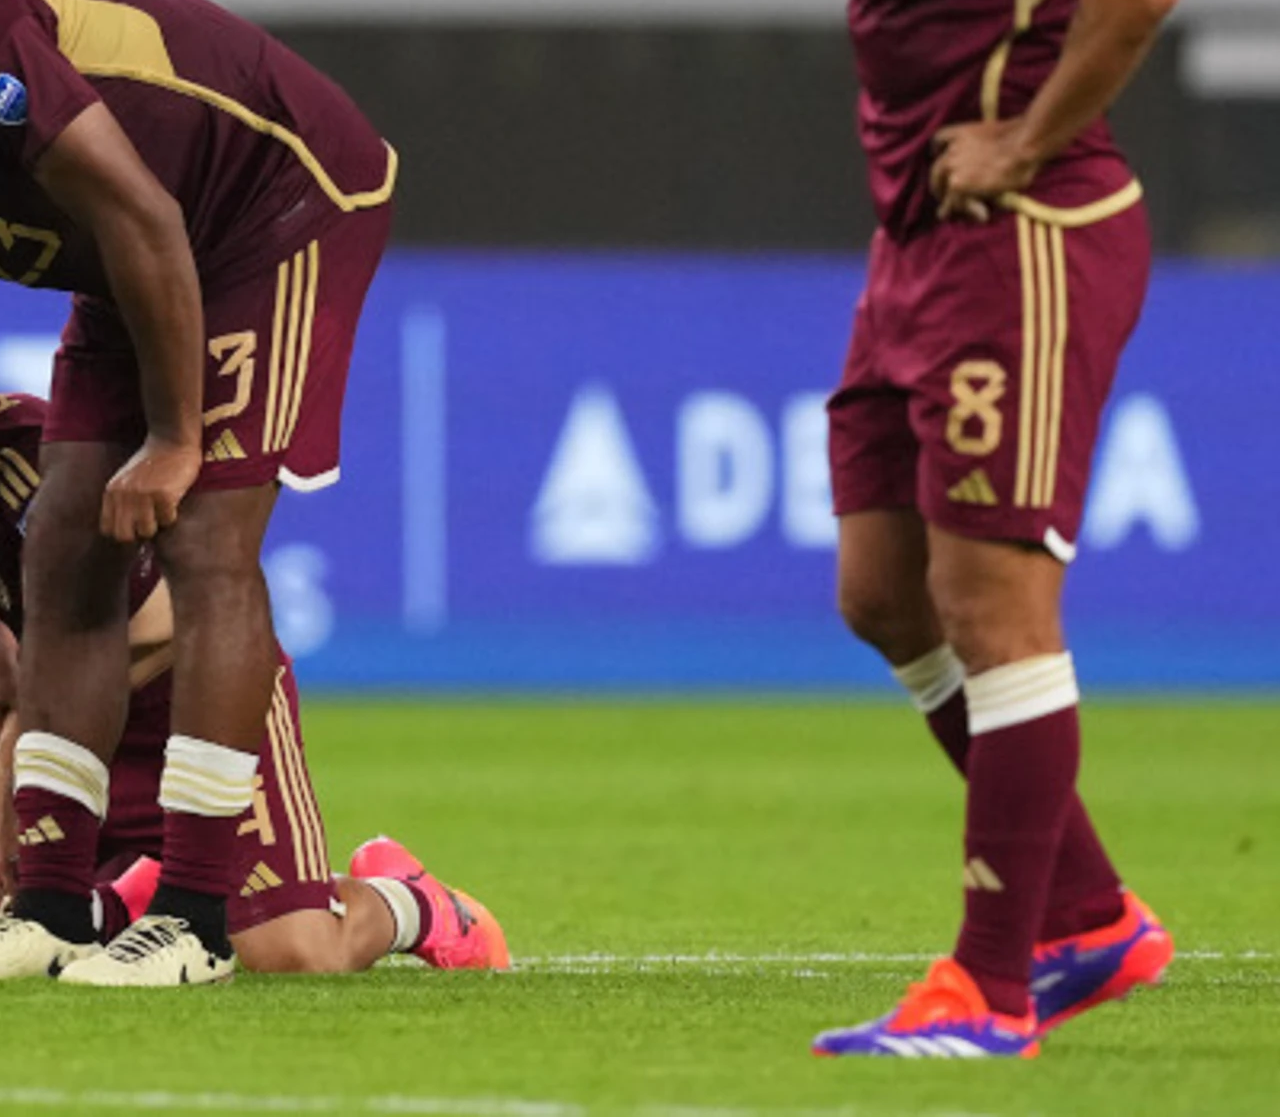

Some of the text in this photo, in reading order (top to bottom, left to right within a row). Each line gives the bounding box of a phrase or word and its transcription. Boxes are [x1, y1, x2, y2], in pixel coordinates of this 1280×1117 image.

[204, 330, 257, 426] 3
[946, 359, 1007, 456] 8
[677, 388, 1200, 551] DEA
